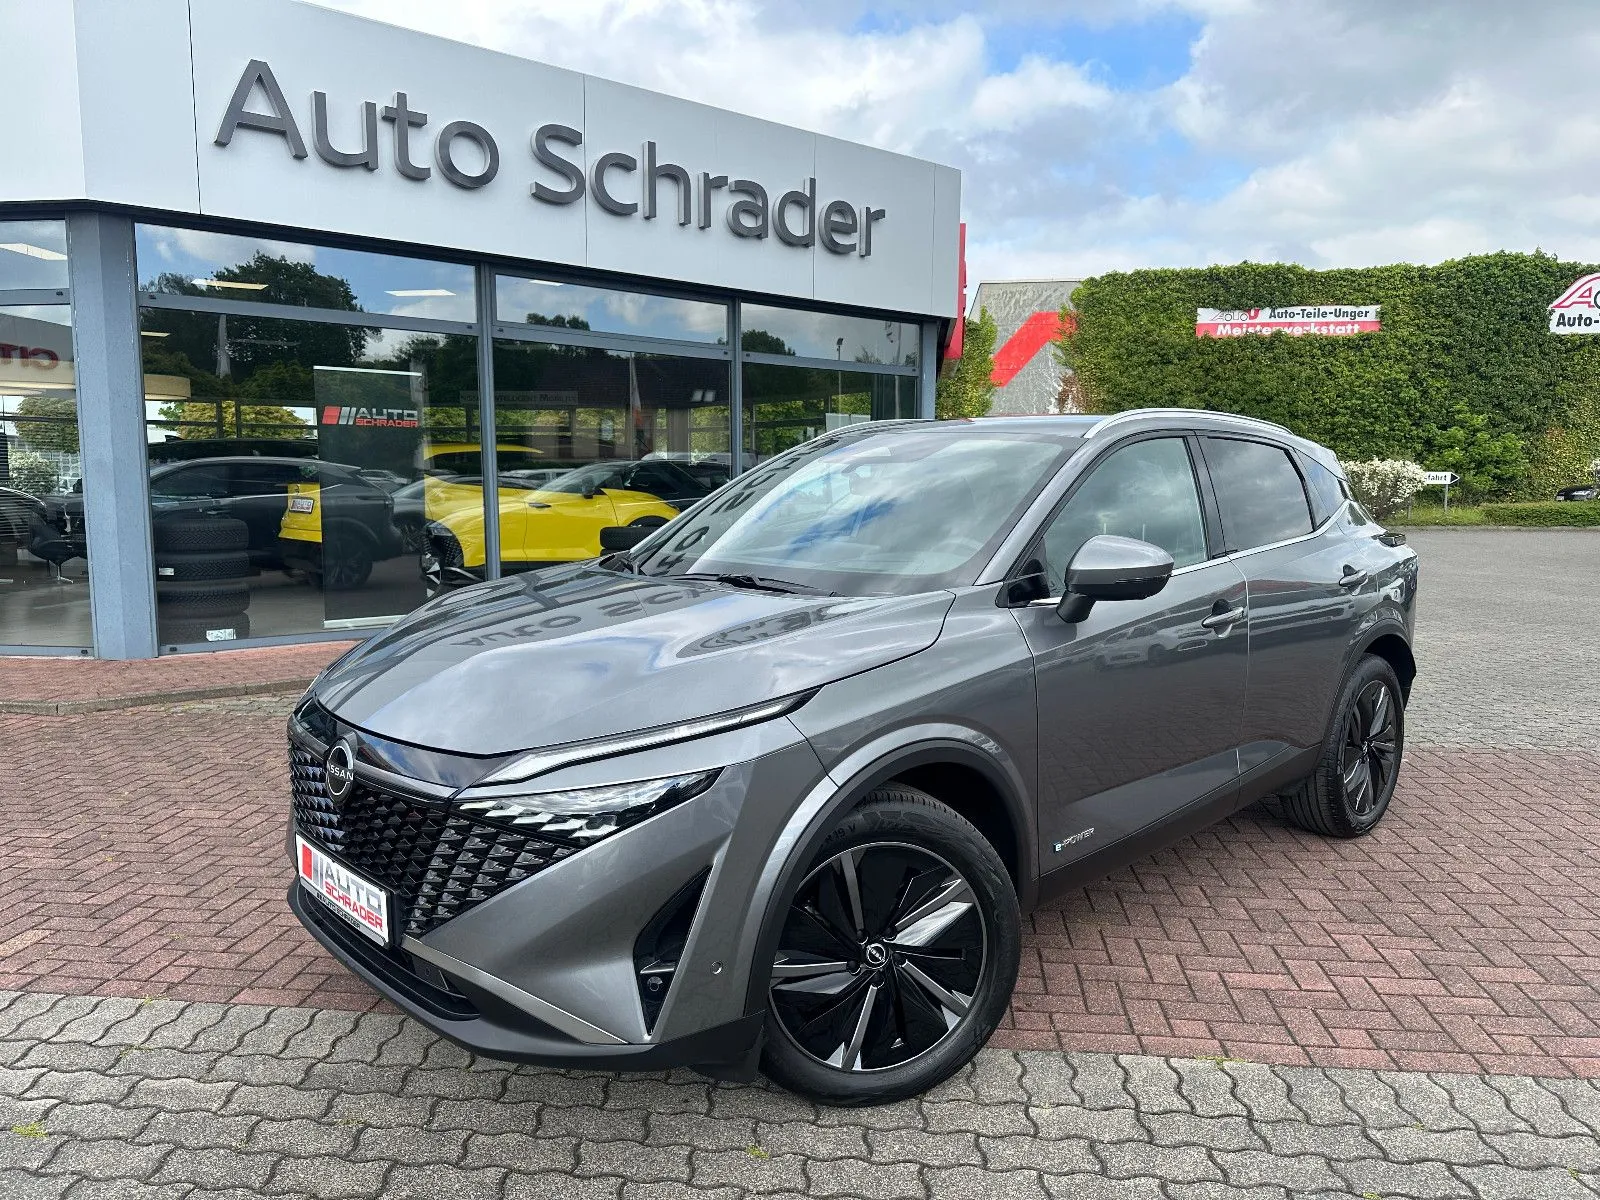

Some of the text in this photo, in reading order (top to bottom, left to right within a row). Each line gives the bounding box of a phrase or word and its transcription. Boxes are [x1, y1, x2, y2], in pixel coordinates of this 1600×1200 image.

[213, 58, 886, 258] Auto Schrader
[1268, 307, 1370, 321] Auto-Teile-Unger
[1555, 312, 1600, 327] Auto-
[356, 407, 418, 420] AUTO
[355, 417, 418, 428] SCHRADER
[1425, 473, 1447, 481] fahrt
[326, 760, 354, 781] SSAN
[324, 861, 383, 917] AUTO
[324, 881, 384, 932] SCHRADER
